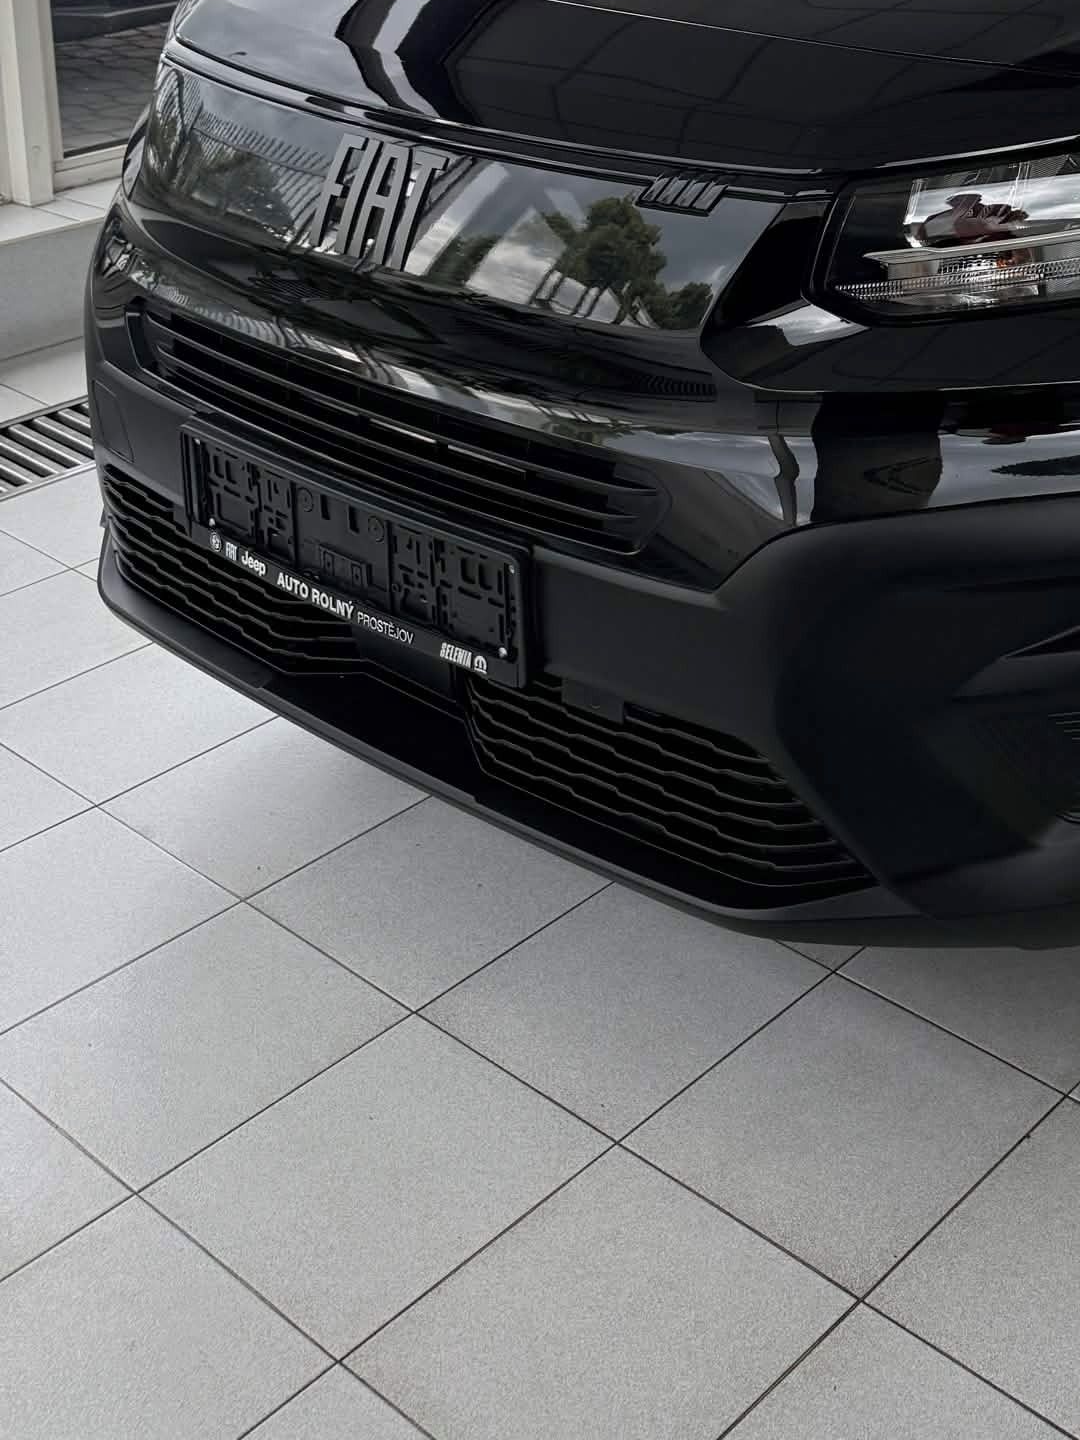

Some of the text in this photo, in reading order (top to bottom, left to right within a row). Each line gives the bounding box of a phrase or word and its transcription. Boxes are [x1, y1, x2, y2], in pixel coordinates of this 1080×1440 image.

[309, 133, 448, 272] FIAT
[225, 542, 472, 669] FIAT Jeep AUTO ROLNÝ PROSTĚJOV SELENIA
